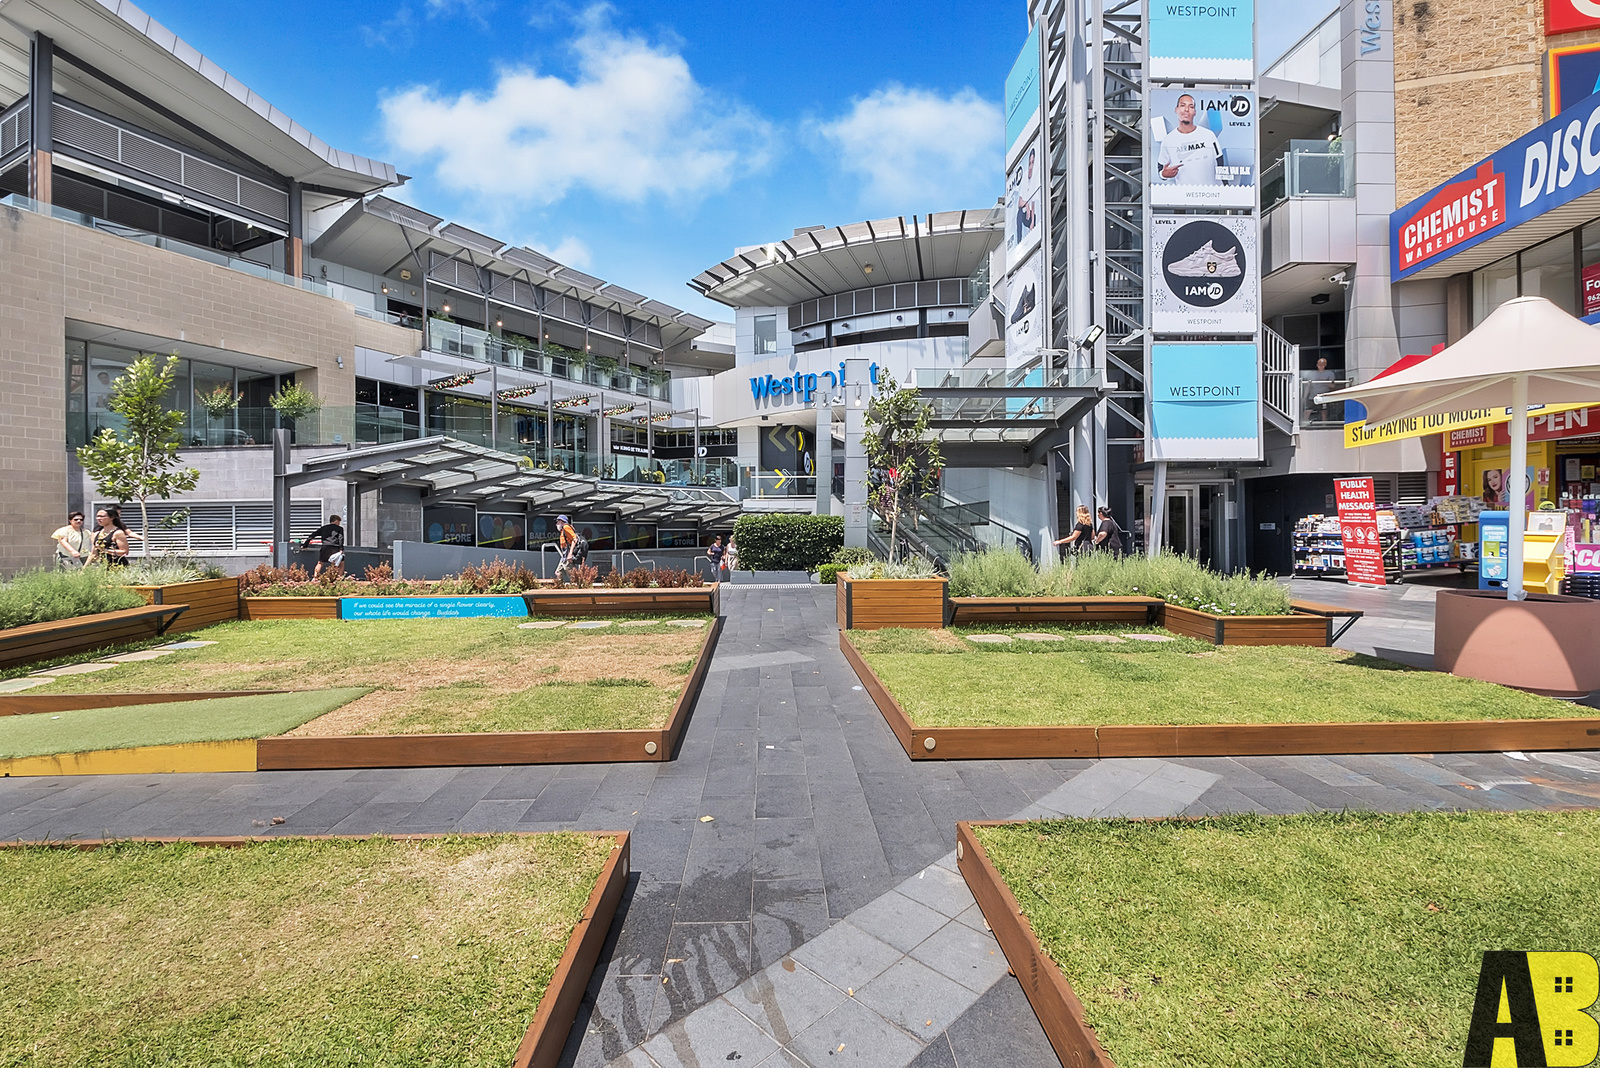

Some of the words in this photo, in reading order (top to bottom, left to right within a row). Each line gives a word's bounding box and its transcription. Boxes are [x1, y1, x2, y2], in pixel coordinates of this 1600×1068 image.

[1166, 5, 1237, 17] WESTPOINT
[1206, 100, 1228, 111] AM
[1404, 179, 1498, 249] CHEMIST
[1405, 209, 1499, 264] WAREHOUSE
[1190, 286, 1206, 296] AM
[1169, 385, 1241, 397] WESTPOINT
[1352, 426, 1377, 442] STOP
[1379, 417, 1417, 437] PAYING
[1451, 427, 1485, 441] CHEMIST
[1452, 437, 1485, 446] WAREHOUSE
[1340, 480, 1367, 489] PUBLIC
[1340, 491, 1369, 500] HEALTH
[1338, 502, 1374, 511] MESSAGE
[444, 533, 472, 543] STORE
[673, 538, 695, 546] STORE
[410, 609, 431, 617] change
